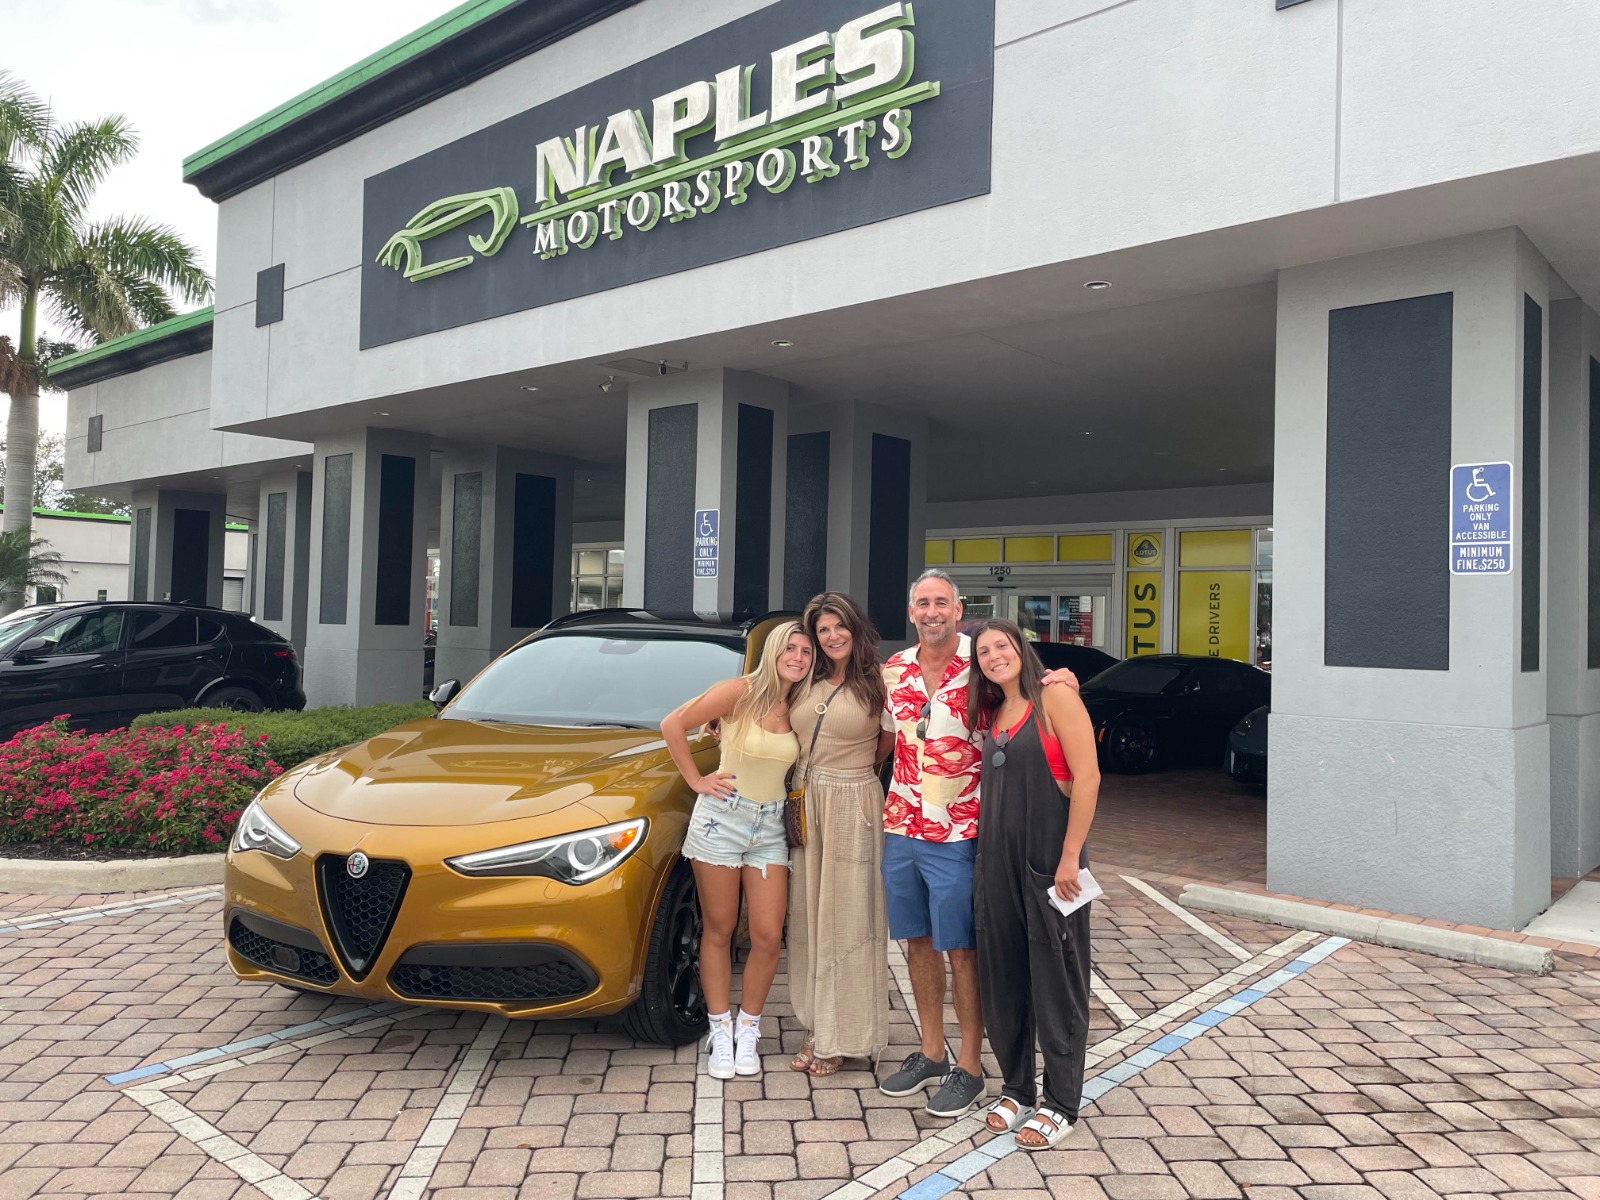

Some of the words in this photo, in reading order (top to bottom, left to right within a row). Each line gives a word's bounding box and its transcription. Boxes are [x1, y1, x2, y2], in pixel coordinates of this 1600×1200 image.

[535, 1, 909, 204] NAPLES
[533, 108, 907, 257] MOTORSPORTS
[1463, 504, 1499, 512] PARKING
[1456, 531, 1506, 540] ACCESSIBLE
[696, 537, 718, 546] PARKING
[700, 548, 714, 557] ONLY
[1460, 547, 1502, 557] MINIMUM
[1457, 559, 1478, 570] FINE
[1482, 558, 1505, 570] $250
[989, 566, 1011, 575] 1250
[1209, 583, 1220, 645] DRIVERS
